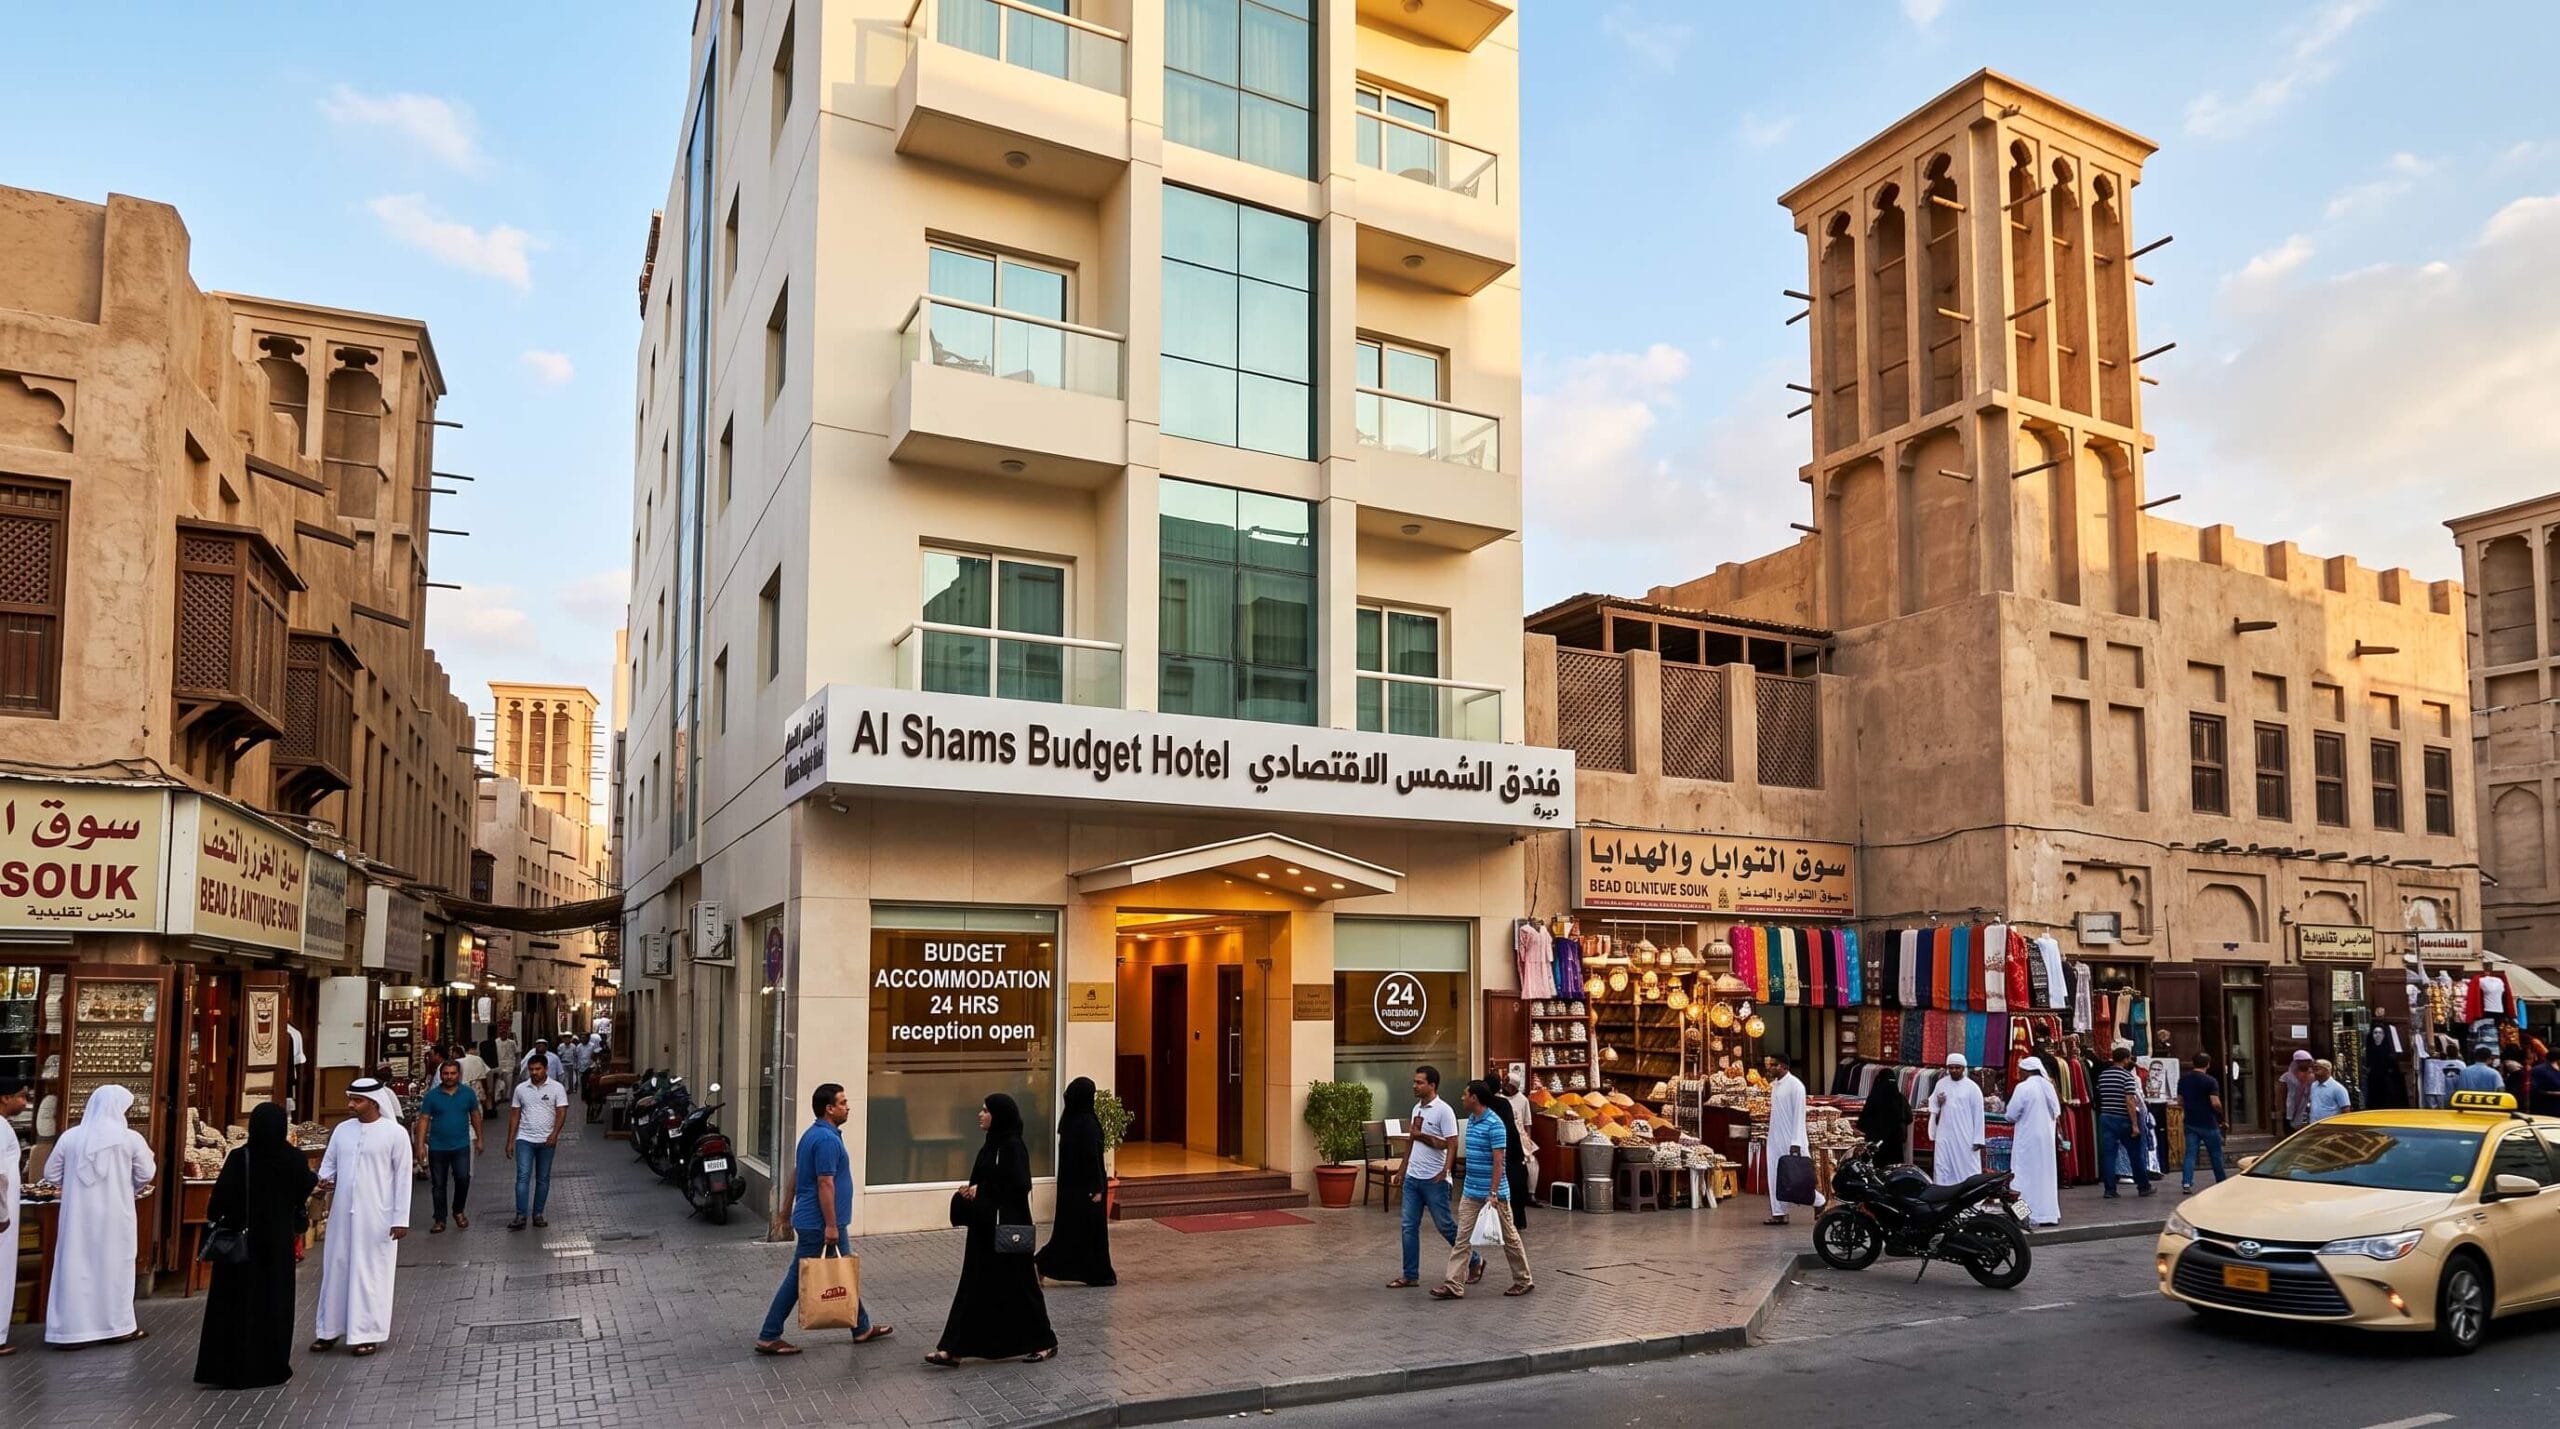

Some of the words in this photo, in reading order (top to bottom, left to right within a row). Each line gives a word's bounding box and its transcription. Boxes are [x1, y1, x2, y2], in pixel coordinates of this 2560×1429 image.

[852, 710, 889, 756] Al
[901, 713, 1017, 765] Shams
[1028, 724, 1142, 782] Budget
[1152, 734, 1230, 780] Hotel
[1249, 745, 1388, 793] الاقتصادي
[1396, 755, 1493, 795] الشمس
[1500, 764, 1561, 803] فندق
[31, 799, 141, 850] سوق
[1533, 803, 1560, 820] ديرة
[203, 817, 249, 879] والتحف
[1590, 834, 1693, 876] والهدايا
[1700, 842, 1785, 879] التوابل
[1792, 848, 1846, 883] سوق
[0, 861, 139, 900] SOUK
[280, 849, 299, 892] سوق
[1590, 879, 1621, 893] BEAD
[1680, 883, 1709, 897] SOUK
[27, 905, 83, 920] تقليدية
[200, 877, 228, 916] BEAD
[230, 885, 237, 919] &
[239, 888, 277, 931] ANTIQUE
[925, 943, 1006, 963] BUDGET
[875, 968, 1050, 989] ACCOMMODATION
[1386, 982, 1415, 1006] 24
[930, 995, 953, 1014] 24
[959, 995, 1000, 1015] HRS
[892, 1021, 982, 1044] reception
[989, 1024, 1035, 1044] open
